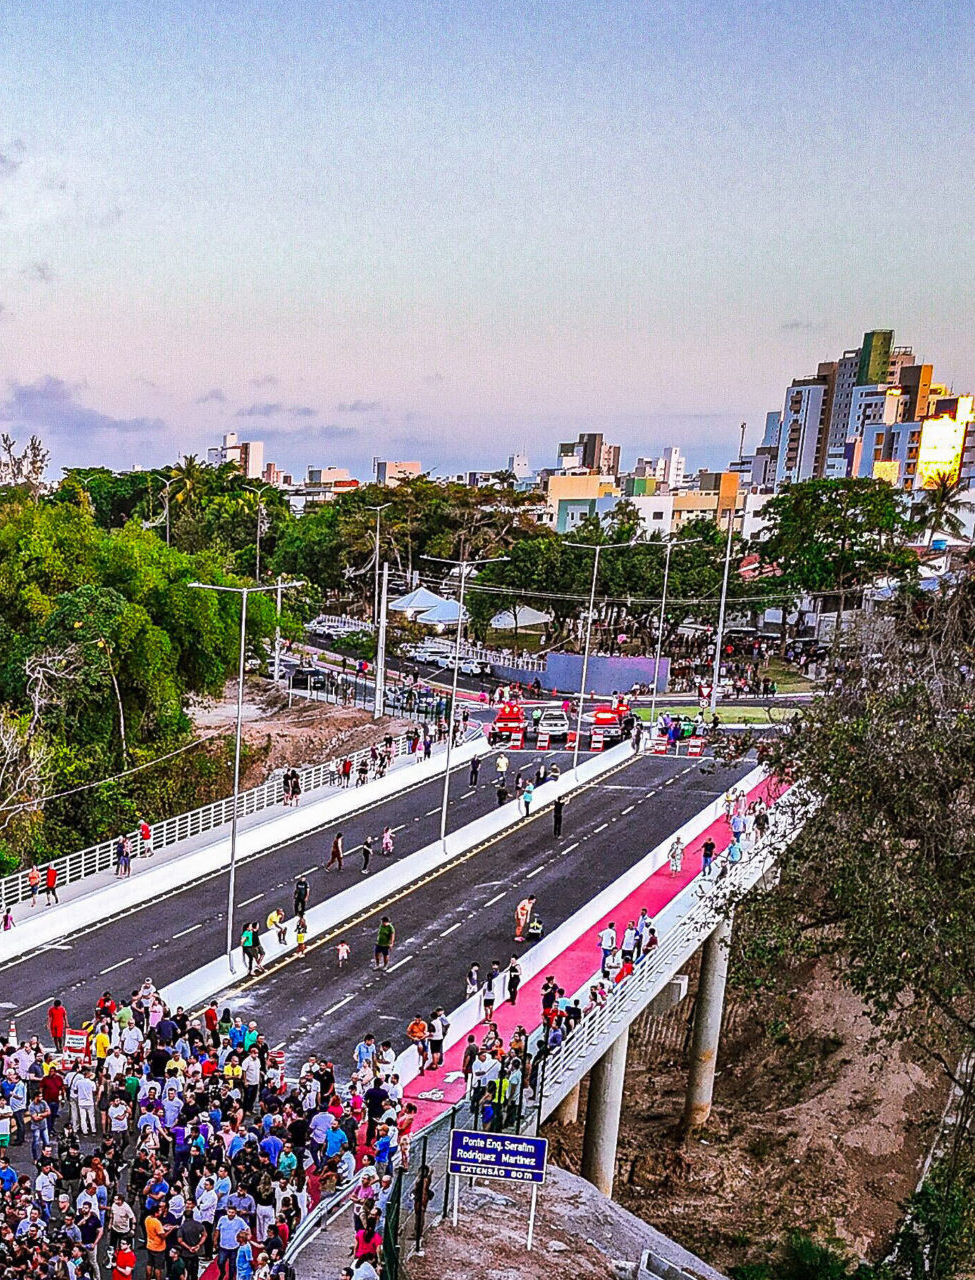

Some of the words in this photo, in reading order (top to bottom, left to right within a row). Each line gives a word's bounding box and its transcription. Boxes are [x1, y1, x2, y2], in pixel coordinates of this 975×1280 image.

[463, 1136, 485, 1147] Ponte
[486, 1139, 503, 1151] Eng.
[504, 1141, 534, 1153] Serafim
[457, 1149, 496, 1162] Rodriguez
[502, 1153, 536, 1165] Martinez
[460, 1166, 505, 1176] EXTENSÃO
